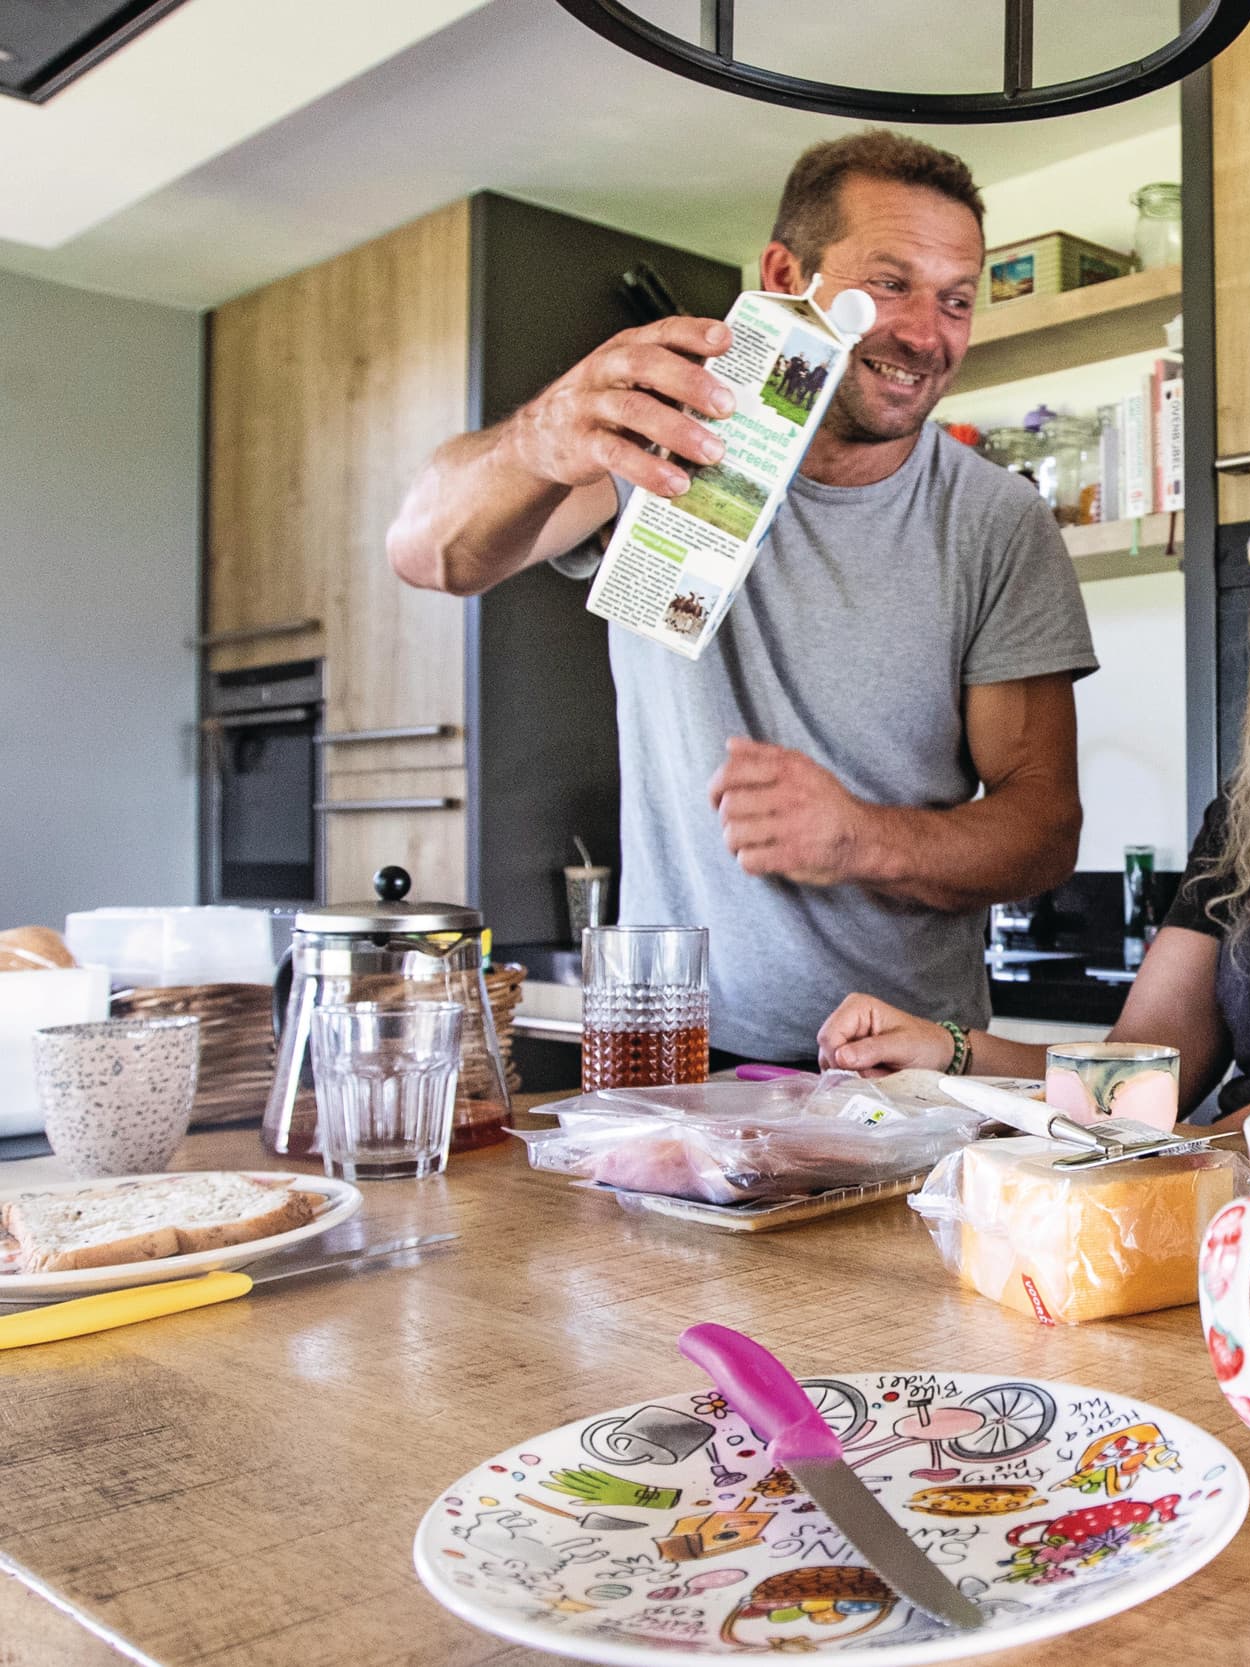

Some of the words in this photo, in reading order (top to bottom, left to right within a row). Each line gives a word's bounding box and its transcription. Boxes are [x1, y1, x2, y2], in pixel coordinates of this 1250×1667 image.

[1025, 1281, 1049, 1324] VOORD
[876, 1375, 937, 1391] rides
[1086, 1409, 1141, 1437] Have
[958, 1466, 1050, 1484] fruity
[993, 1458, 1028, 1475] pie
